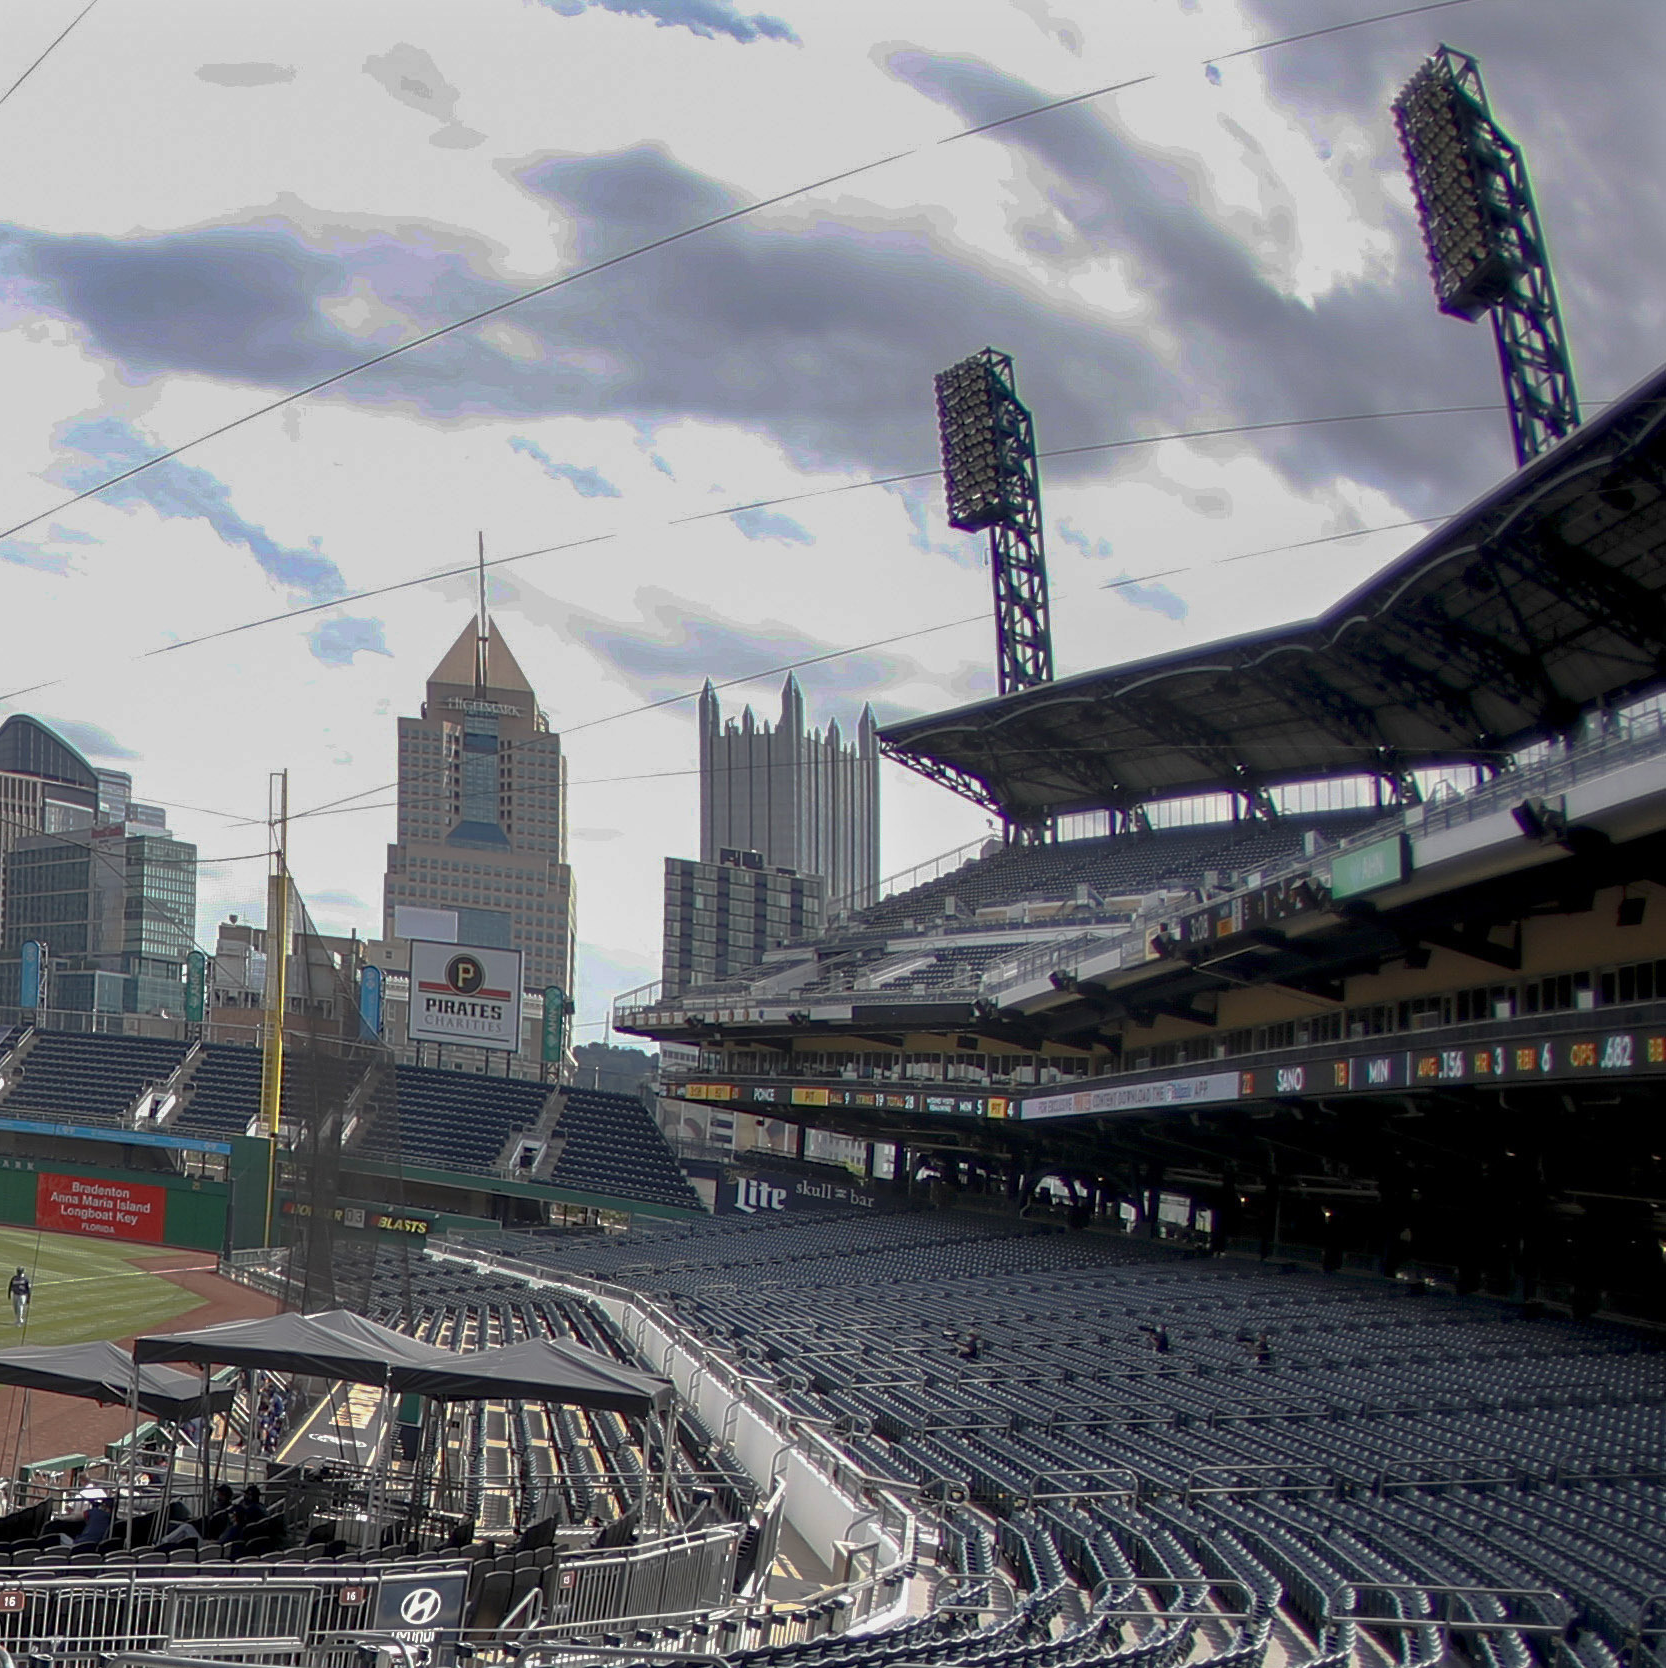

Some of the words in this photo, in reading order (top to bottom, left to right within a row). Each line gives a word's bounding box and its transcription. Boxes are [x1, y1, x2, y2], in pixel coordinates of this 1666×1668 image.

[458, 963, 475, 988] P
[424, 997, 503, 1020] PIRATES
[423, 1013, 503, 1034] CHARITIES
[1277, 1067, 1304, 1092] SANO
[1368, 1058, 1388, 1083] MIN
[1417, 1055, 1437, 1078] AVG
[1438, 1051, 1465, 1079] .156
[1474, 1052, 1491, 1073] HR
[1494, 1046, 1505, 1075] 3
[1516, 1048, 1535, 1071] RBI
[1541, 1042, 1552, 1073] 6
[1570, 1043, 1598, 1068] OPS
[1600, 1035, 1634, 1068] .682
[71, 1181, 131, 1198] Bradenton
[734, 1175, 788, 1214] Lite
[795, 1181, 832, 1200] skull
[850, 1189, 876, 1209] bar
[50, 1191, 79, 1206] Anna
[82, 1195, 114, 1210] Maria
[116, 1199, 151, 1214] Island
[60, 1204, 113, 1223] Longboat
[116, 1210, 139, 1226] Key
[377, 1215, 428, 1234] BLASTS
[81, 1222, 116, 1235] FLORIDA
[4, 1597, 16, 1607] 16
[346, 1592, 356, 1601] 16
